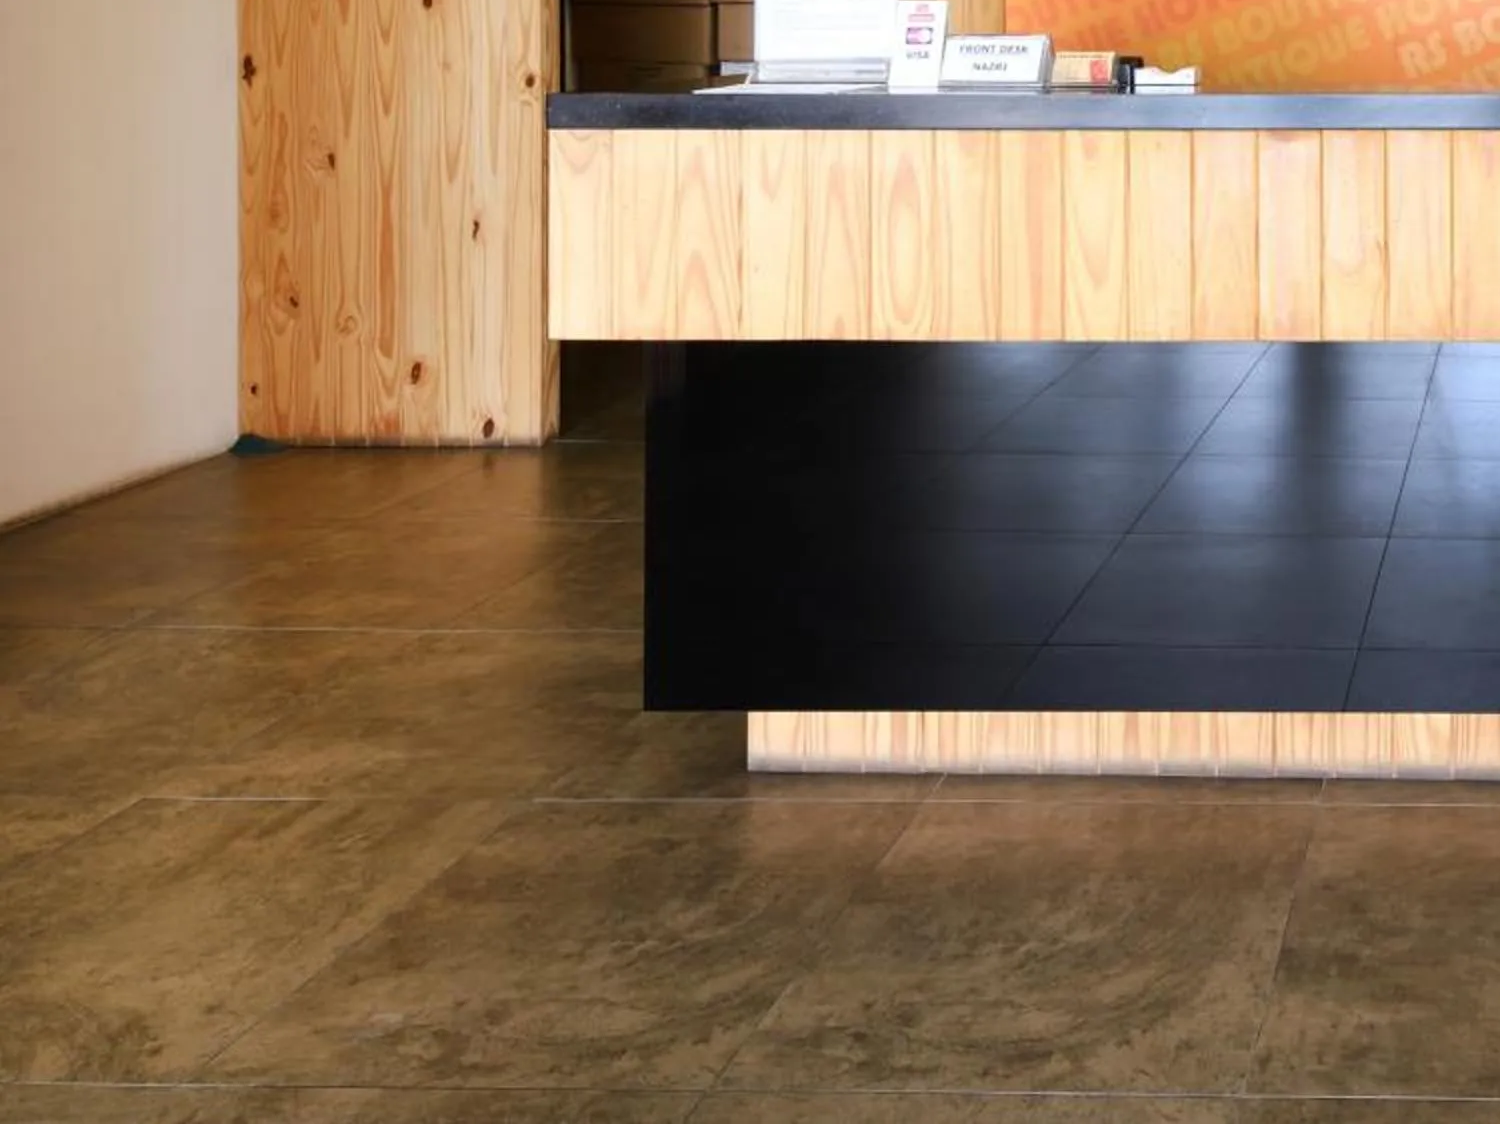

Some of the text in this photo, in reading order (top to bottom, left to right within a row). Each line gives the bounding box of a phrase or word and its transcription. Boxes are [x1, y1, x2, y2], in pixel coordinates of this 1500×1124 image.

[959, 44, 1029, 55] FRONT DESK
[1400, 31, 1448, 77] RS
